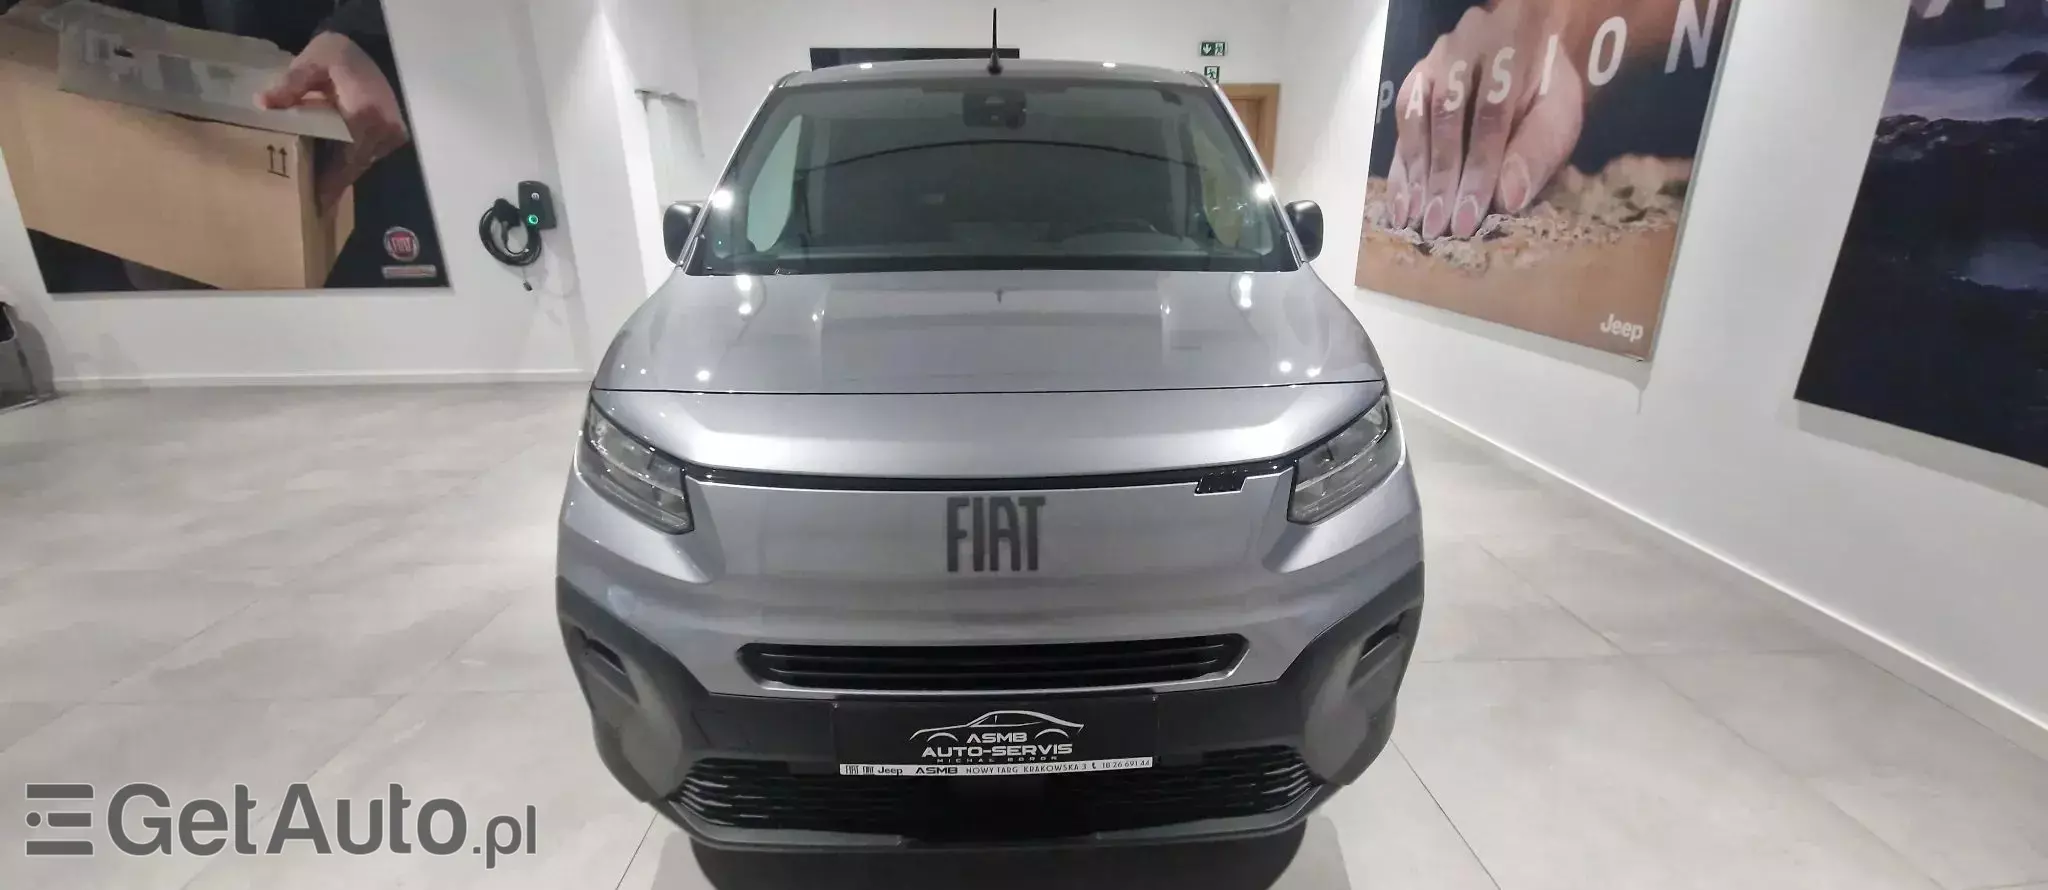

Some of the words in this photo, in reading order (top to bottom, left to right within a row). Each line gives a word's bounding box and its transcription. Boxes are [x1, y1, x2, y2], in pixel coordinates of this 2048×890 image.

[1373, 0, 1717, 124] PASSION
[1600, 313, 1644, 343] Jeep
[946, 496, 1047, 572] FIAT
[966, 732, 1028, 744] ASMB
[921, 743, 1073, 758] AUTO-SERVIS
[877, 766, 904, 776] Jeep
[915, 766, 958, 775] ASMB
[965, 767, 994, 775] NOWY
[996, 766, 1019, 774] TARG
[1023, 764, 1080, 773] KRAKOWSKA
